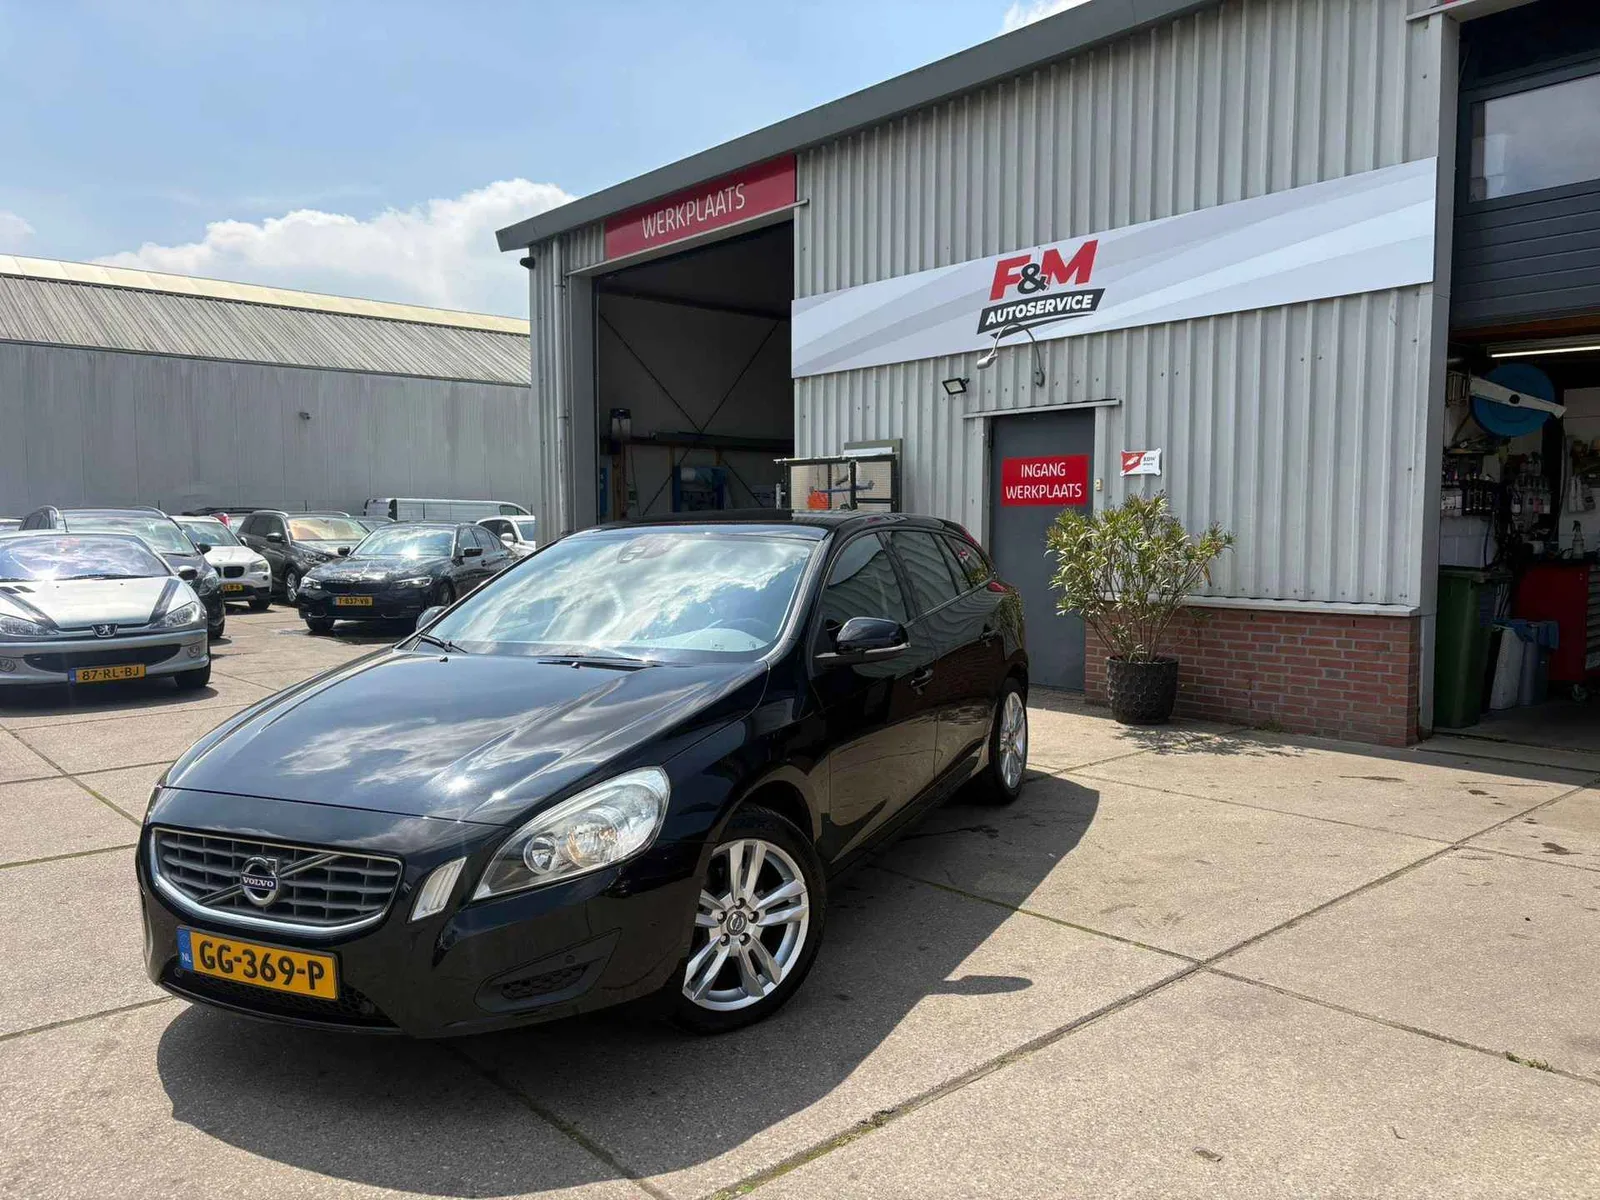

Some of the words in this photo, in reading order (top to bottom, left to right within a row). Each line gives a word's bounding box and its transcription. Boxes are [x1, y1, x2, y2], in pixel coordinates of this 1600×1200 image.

[642, 183, 745, 240] WERKPLAATS
[989, 239, 1099, 301] F&M
[985, 294, 1093, 326] AUTOSERVICE
[1021, 462, 1066, 478] INGANG
[1005, 483, 1082, 499] WERKPLAATS
[82, 666, 139, 681] 87-RL-BJ
[242, 876, 274, 888] VOLVO
[181, 952, 192, 963] NL
[200, 940, 325, 990] GG-369-P
